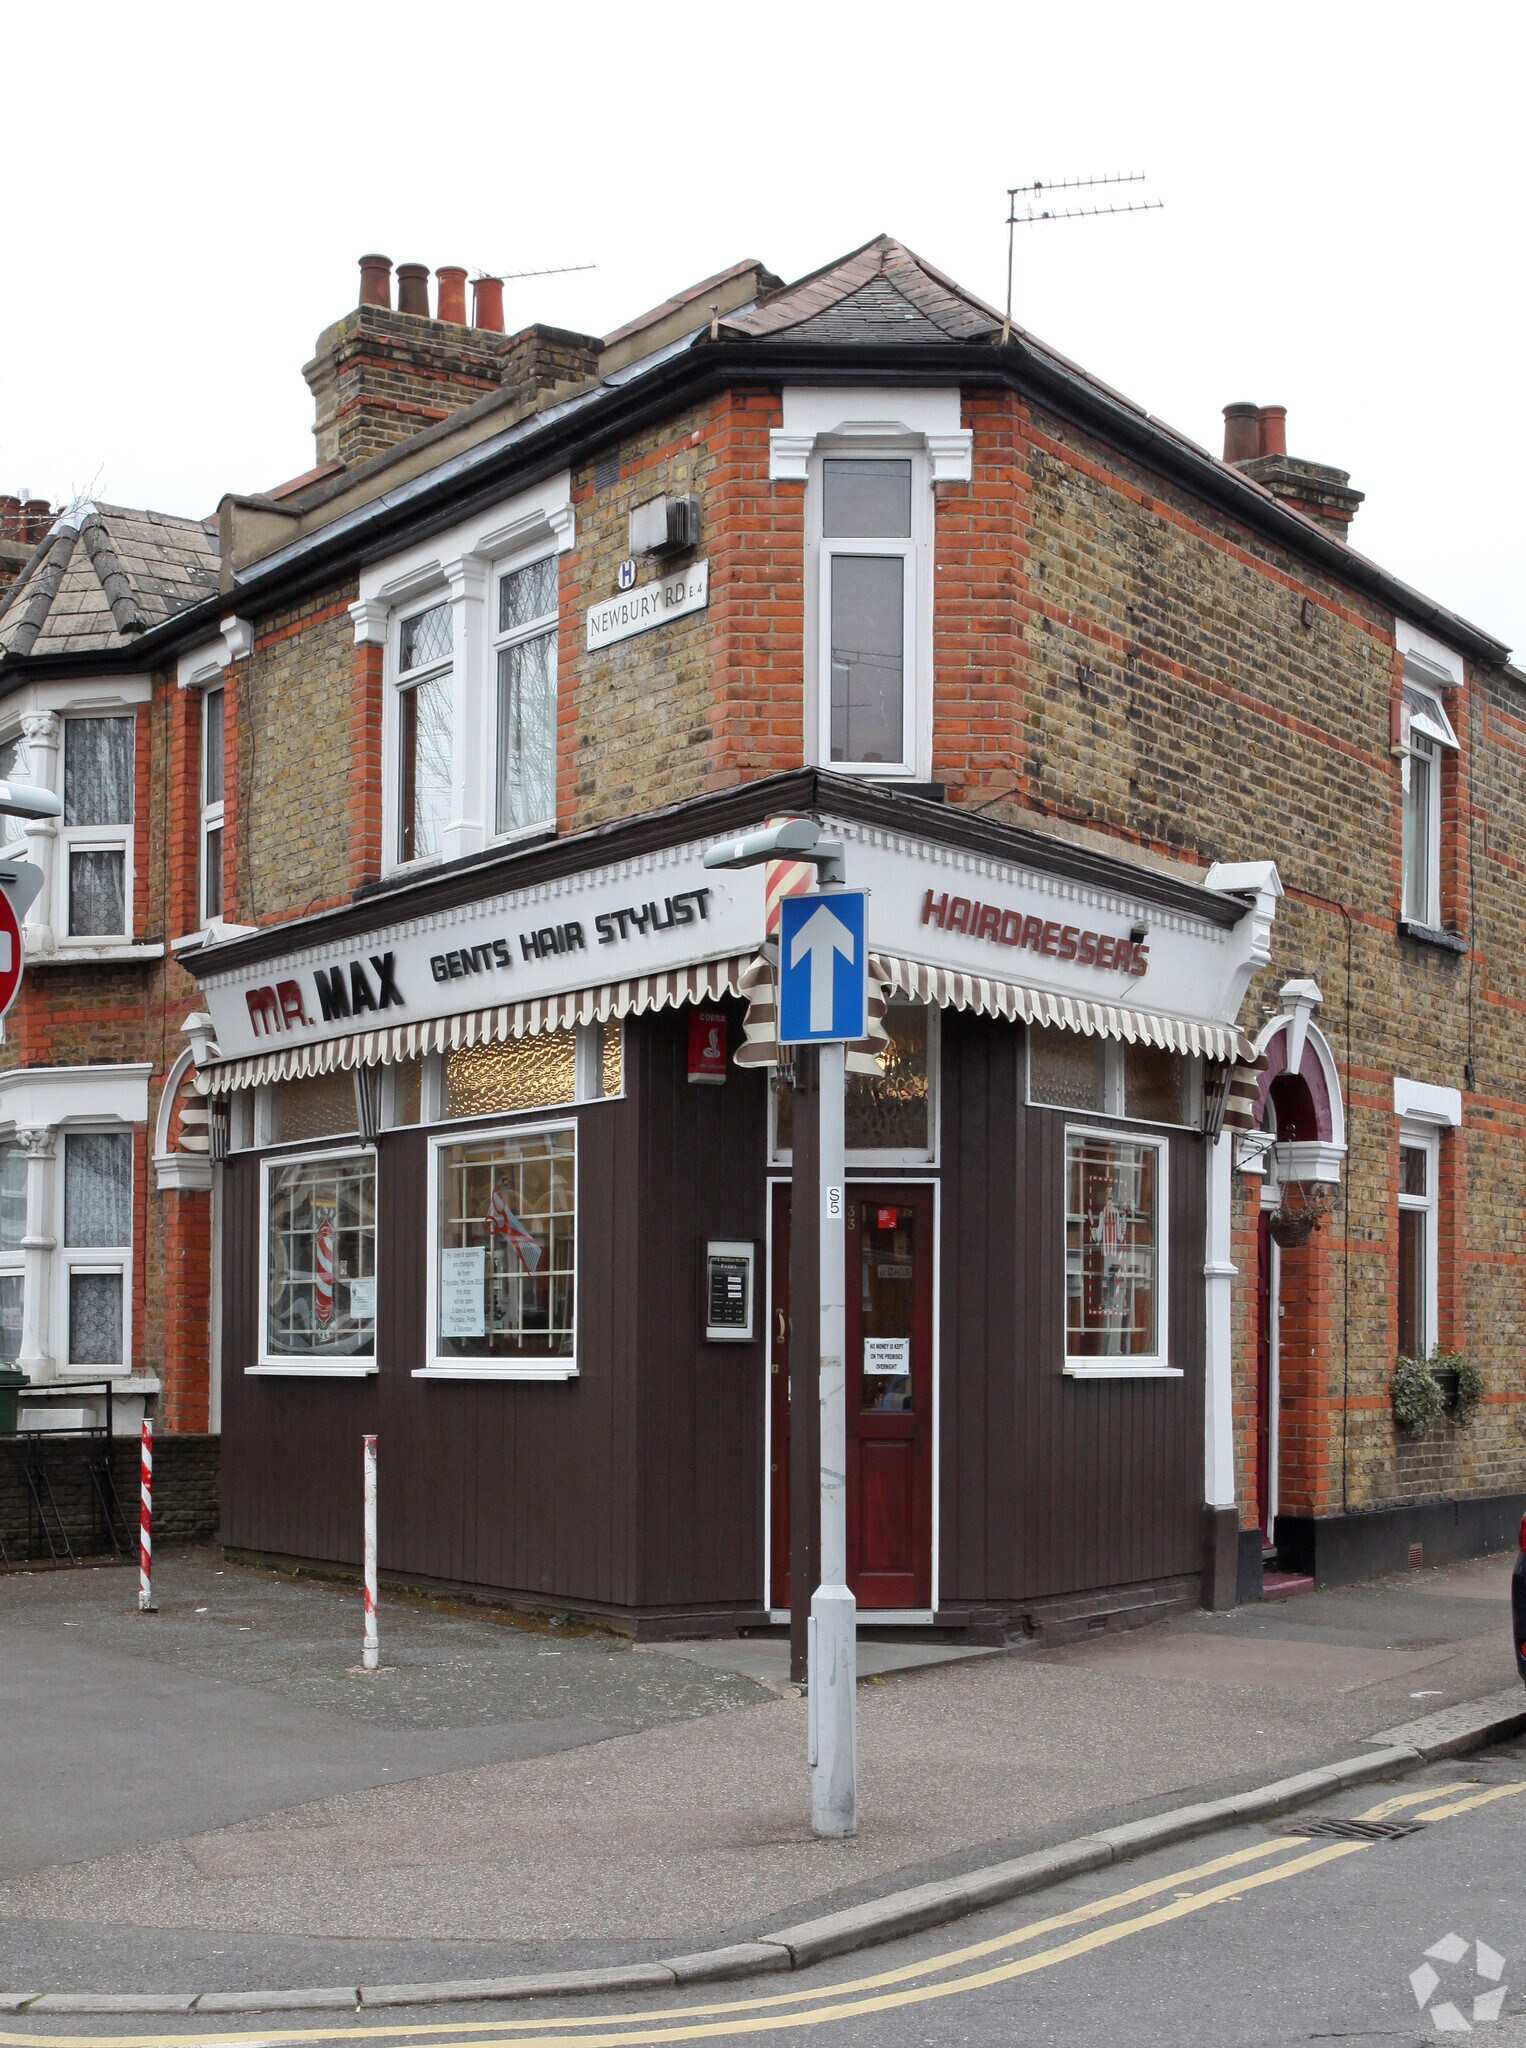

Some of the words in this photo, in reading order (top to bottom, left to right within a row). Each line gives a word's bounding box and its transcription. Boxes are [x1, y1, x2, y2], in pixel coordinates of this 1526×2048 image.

[622, 560, 632, 586] H
[590, 591, 660, 637] NEWBURY
[665, 582, 687, 608] RD.
[313, 951, 404, 1022] MAX
[430, 938, 511, 983] GENTS
[519, 921, 585, 961] HAIR
[595, 887, 711, 945] STYLIST
[922, 888, 1150, 977] HAIRDRESSERS
[699, 1013, 726, 1023] COBRA
